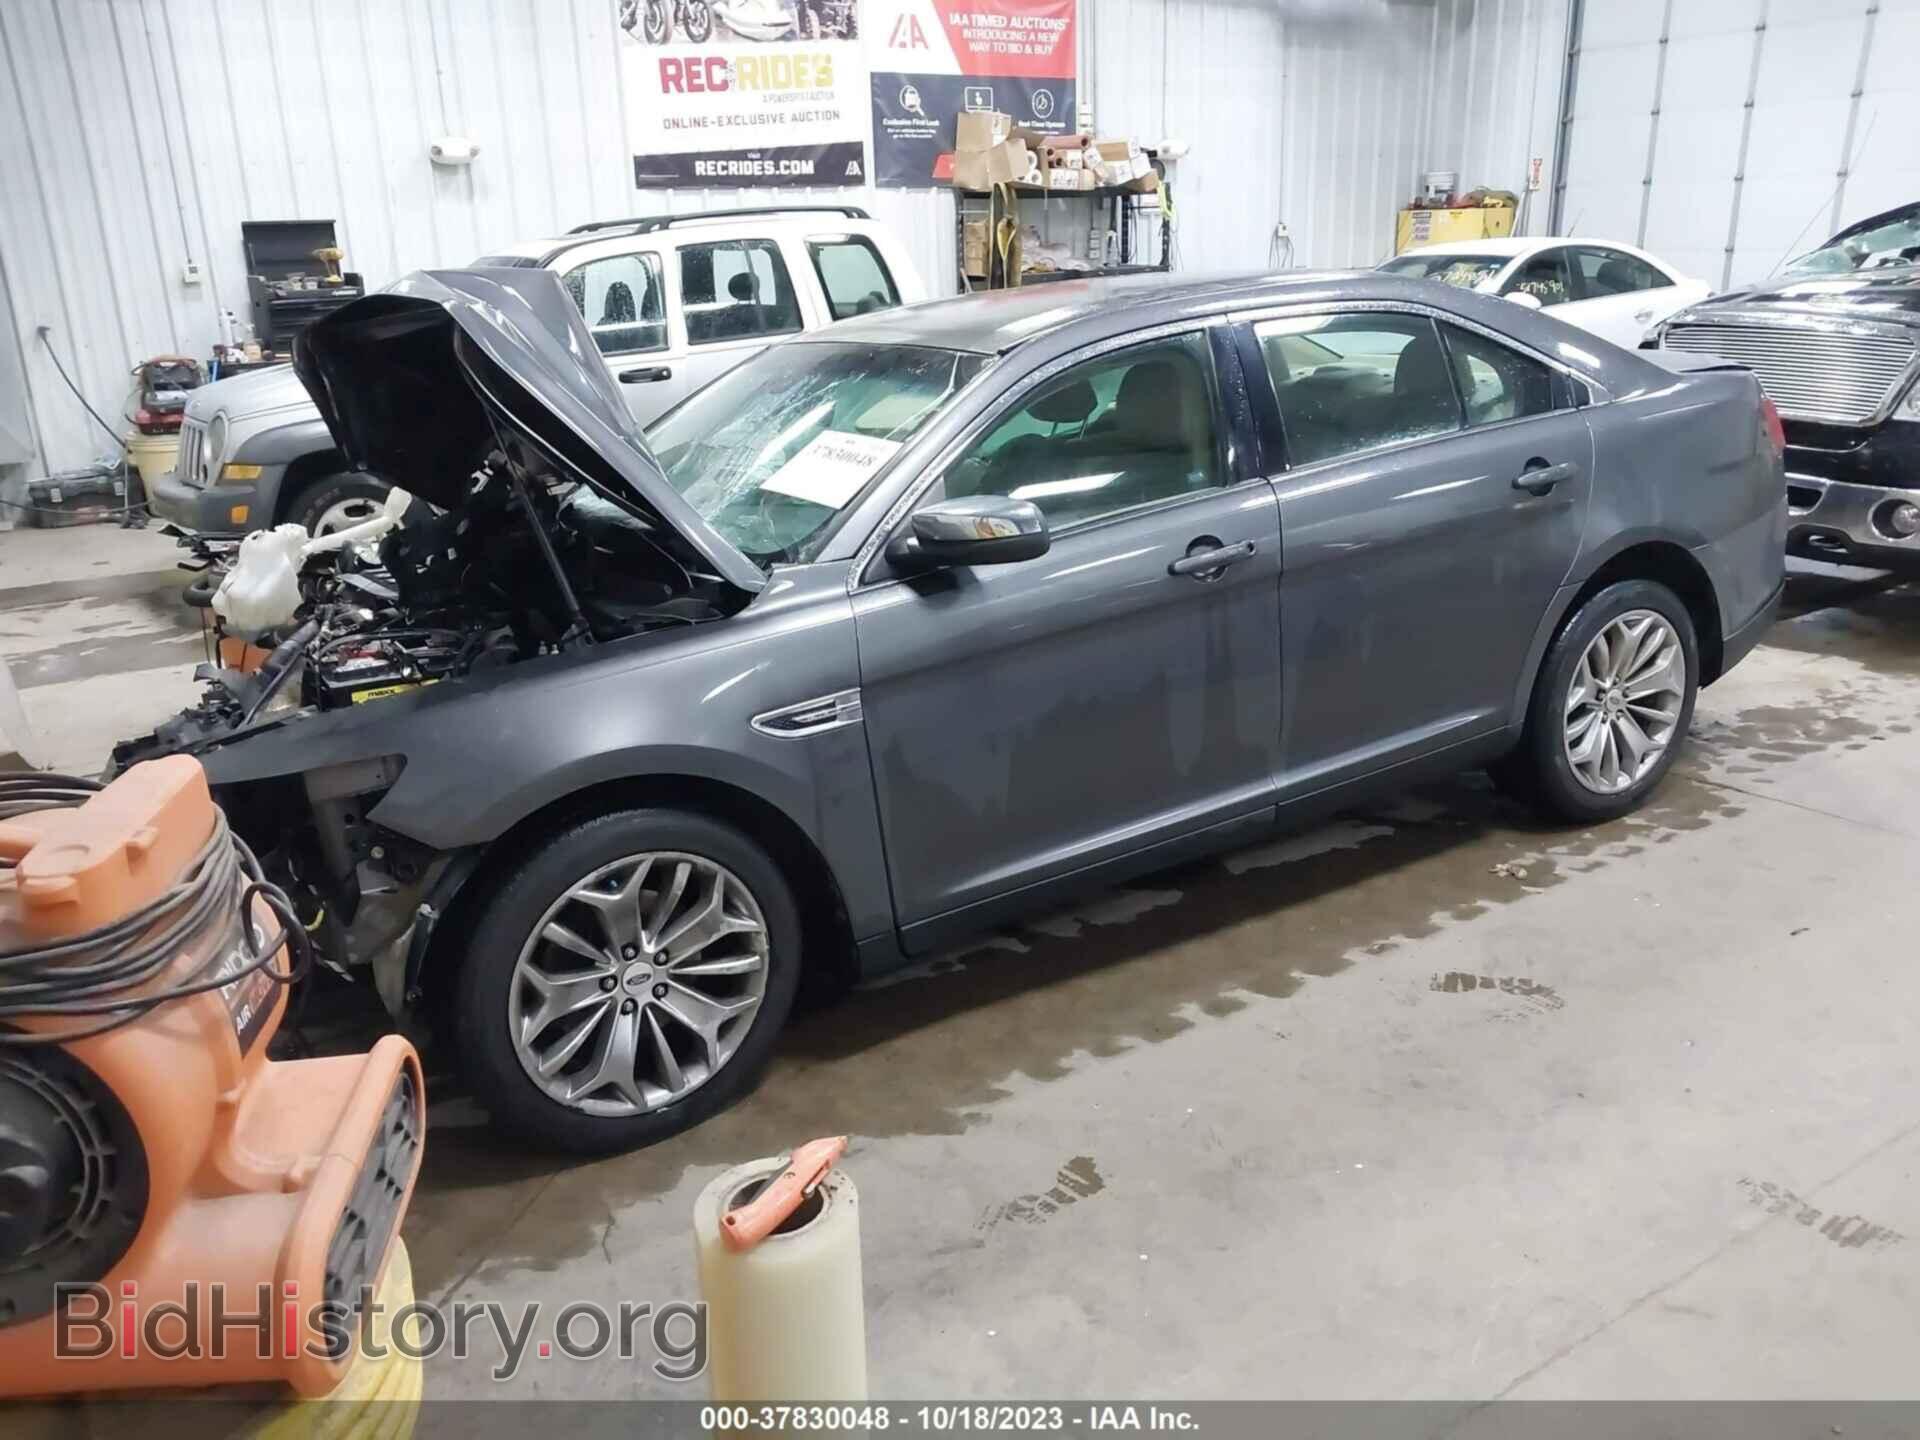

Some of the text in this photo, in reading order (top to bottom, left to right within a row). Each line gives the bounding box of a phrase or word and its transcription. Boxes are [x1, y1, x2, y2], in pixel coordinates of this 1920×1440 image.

[949, 13, 969, 26] IAA
[971, 14, 1007, 28] TIMED
[962, 28, 1060, 43] INTRODUCING A NEW
[968, 40, 991, 52] WAY
[992, 41, 1006, 53] TO
[1034, 44, 1054, 56] BUY
[658, 53, 833, 94] REC RIDES
[663, 109, 840, 130] ONLINE-EXCLUSIVE AUCTION
[694, 159, 815, 176] RECRIDES.COM
